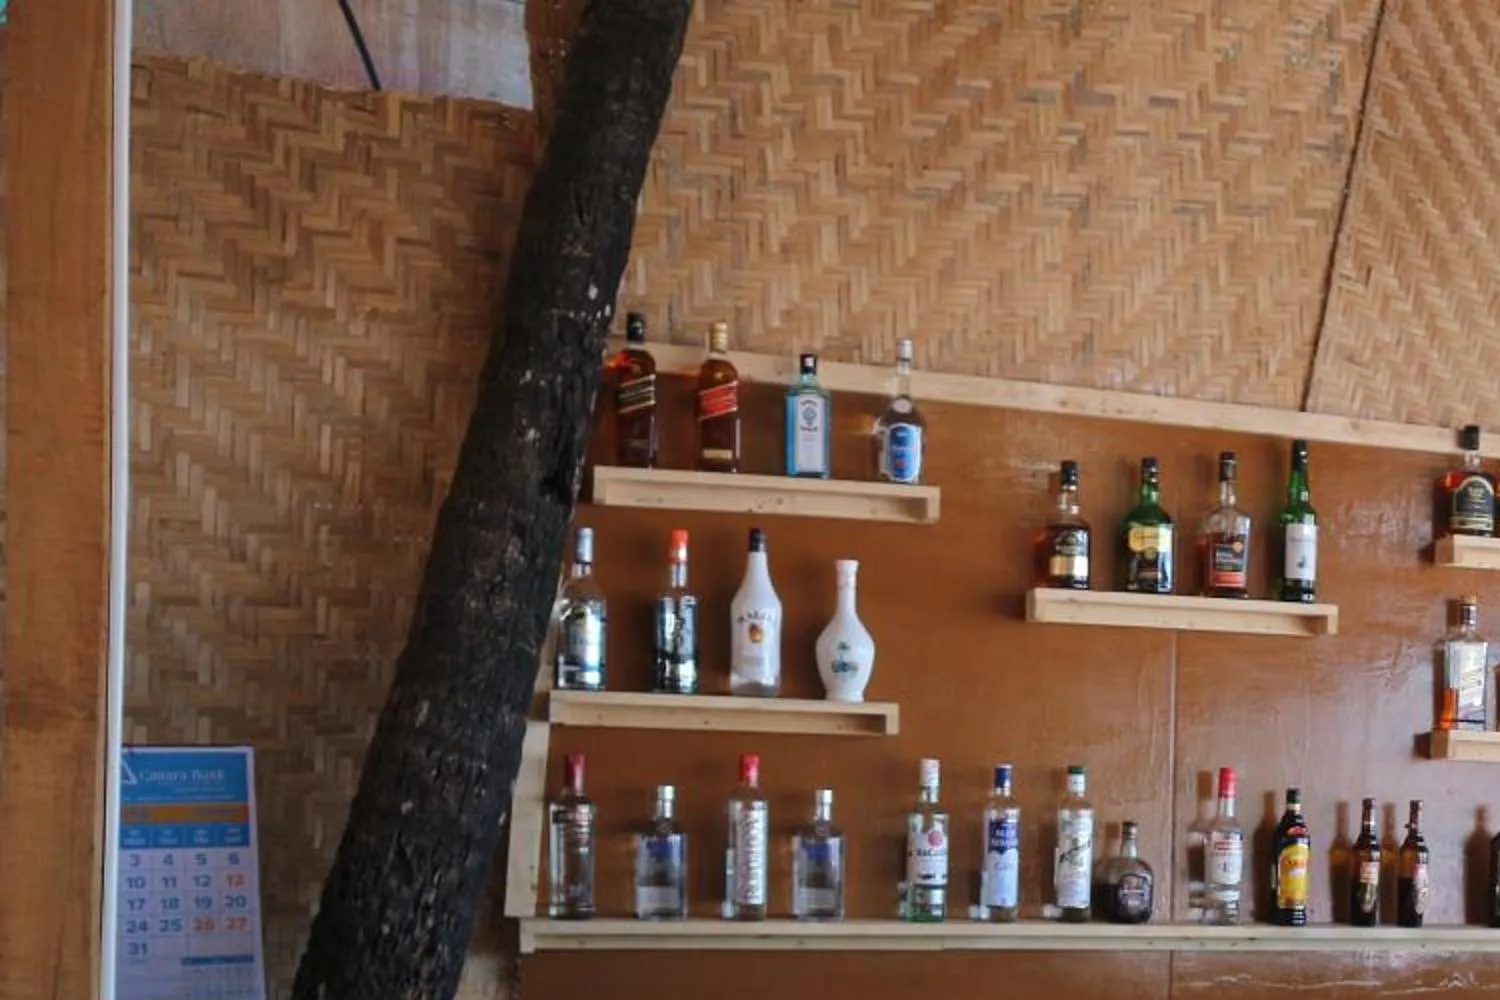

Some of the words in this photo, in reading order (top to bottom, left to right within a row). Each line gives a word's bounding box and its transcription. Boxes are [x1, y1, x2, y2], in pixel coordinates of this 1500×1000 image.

[127, 853, 140, 867] 3
[163, 853, 174, 866] 4
[195, 852, 207, 866] 5
[228, 851, 239, 865] 6
[127, 876, 146, 889] 10
[162, 876, 177, 889] 11
[194, 874, 212, 888] 12
[226, 873, 245, 887] 13
[128, 898, 145, 911] 17
[161, 897, 179, 910] 18
[194, 896, 213, 910] 19
[225, 894, 247, 908] 20
[127, 920, 148, 933] 24
[160, 919, 183, 932] 25
[193, 917, 215, 931] 26
[225, 916, 247, 930] 27
[128, 942, 147, 955] 31
